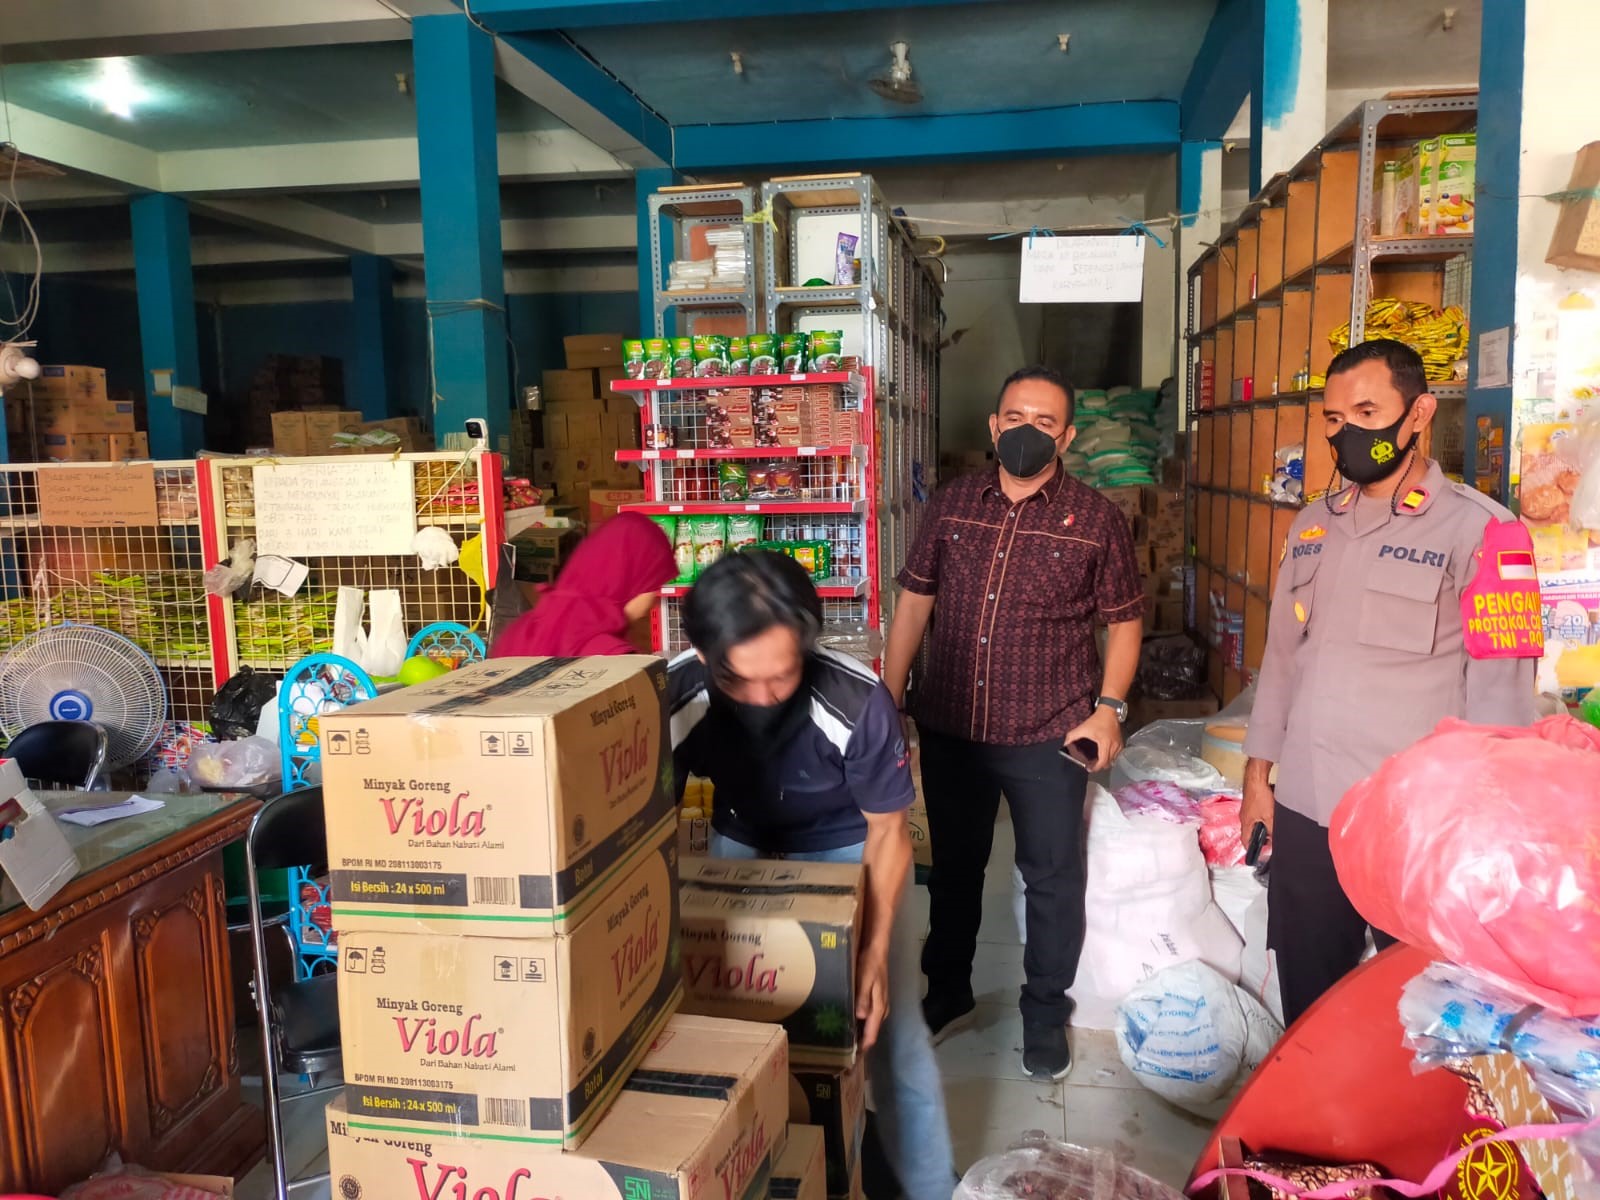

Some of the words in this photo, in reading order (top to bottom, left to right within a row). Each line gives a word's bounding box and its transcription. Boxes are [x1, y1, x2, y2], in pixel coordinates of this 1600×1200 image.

[1378, 545, 1445, 567] POLRI
[1468, 615, 1530, 635] PROTOKOL
[1489, 631, 1517, 649] TNI
[516, 734, 525, 747] 5
[599, 719, 648, 794] Viola
[364, 778, 405, 792] Minyak
[409, 779, 451, 793] Goreng
[379, 790, 487, 838] Viola
[408, 839, 425, 848] Dari
[426, 840, 451, 848] Bahan
[452, 840, 480, 849] Nabati
[482, 841, 505, 850] Alami
[342, 858, 363, 867] BPOM
[365, 859, 373, 868] RI
[374, 860, 387, 868] MD
[351, 881, 361, 892] Isi
[362, 881, 389, 893] Bersih
[396, 882, 407, 894] 24
[408, 885, 414, 894] x
[415, 883, 431, 895] 500
[434, 884, 445, 895] ml
[721, 928, 762, 945] Goreng
[821, 932, 837, 949] SNI
[610, 904, 658, 996] Viola
[529, 961, 538, 973] 5
[684, 952, 778, 993] Viola
[376, 998, 418, 1013] Minyak
[422, 1001, 463, 1015] Goreng
[392, 1013, 500, 1059] Viola
[420, 1058, 437, 1067] Dari
[438, 1059, 462, 1069] Bahan
[464, 1061, 491, 1071] Nabati
[493, 1062, 516, 1072] Alami
[355, 1073, 375, 1083] BPOM
[377, 1075, 385, 1083] RI
[387, 1075, 399, 1084] MD
[585, 1066, 603, 1100] Botol
[816, 1083, 831, 1099] SNI
[362, 1095, 373, 1107] Isi
[375, 1096, 400, 1109] Bersih
[407, 1098, 418, 1110] 24
[419, 1102, 425, 1111] x
[427, 1100, 443, 1112] 500
[445, 1101, 456, 1113] ml
